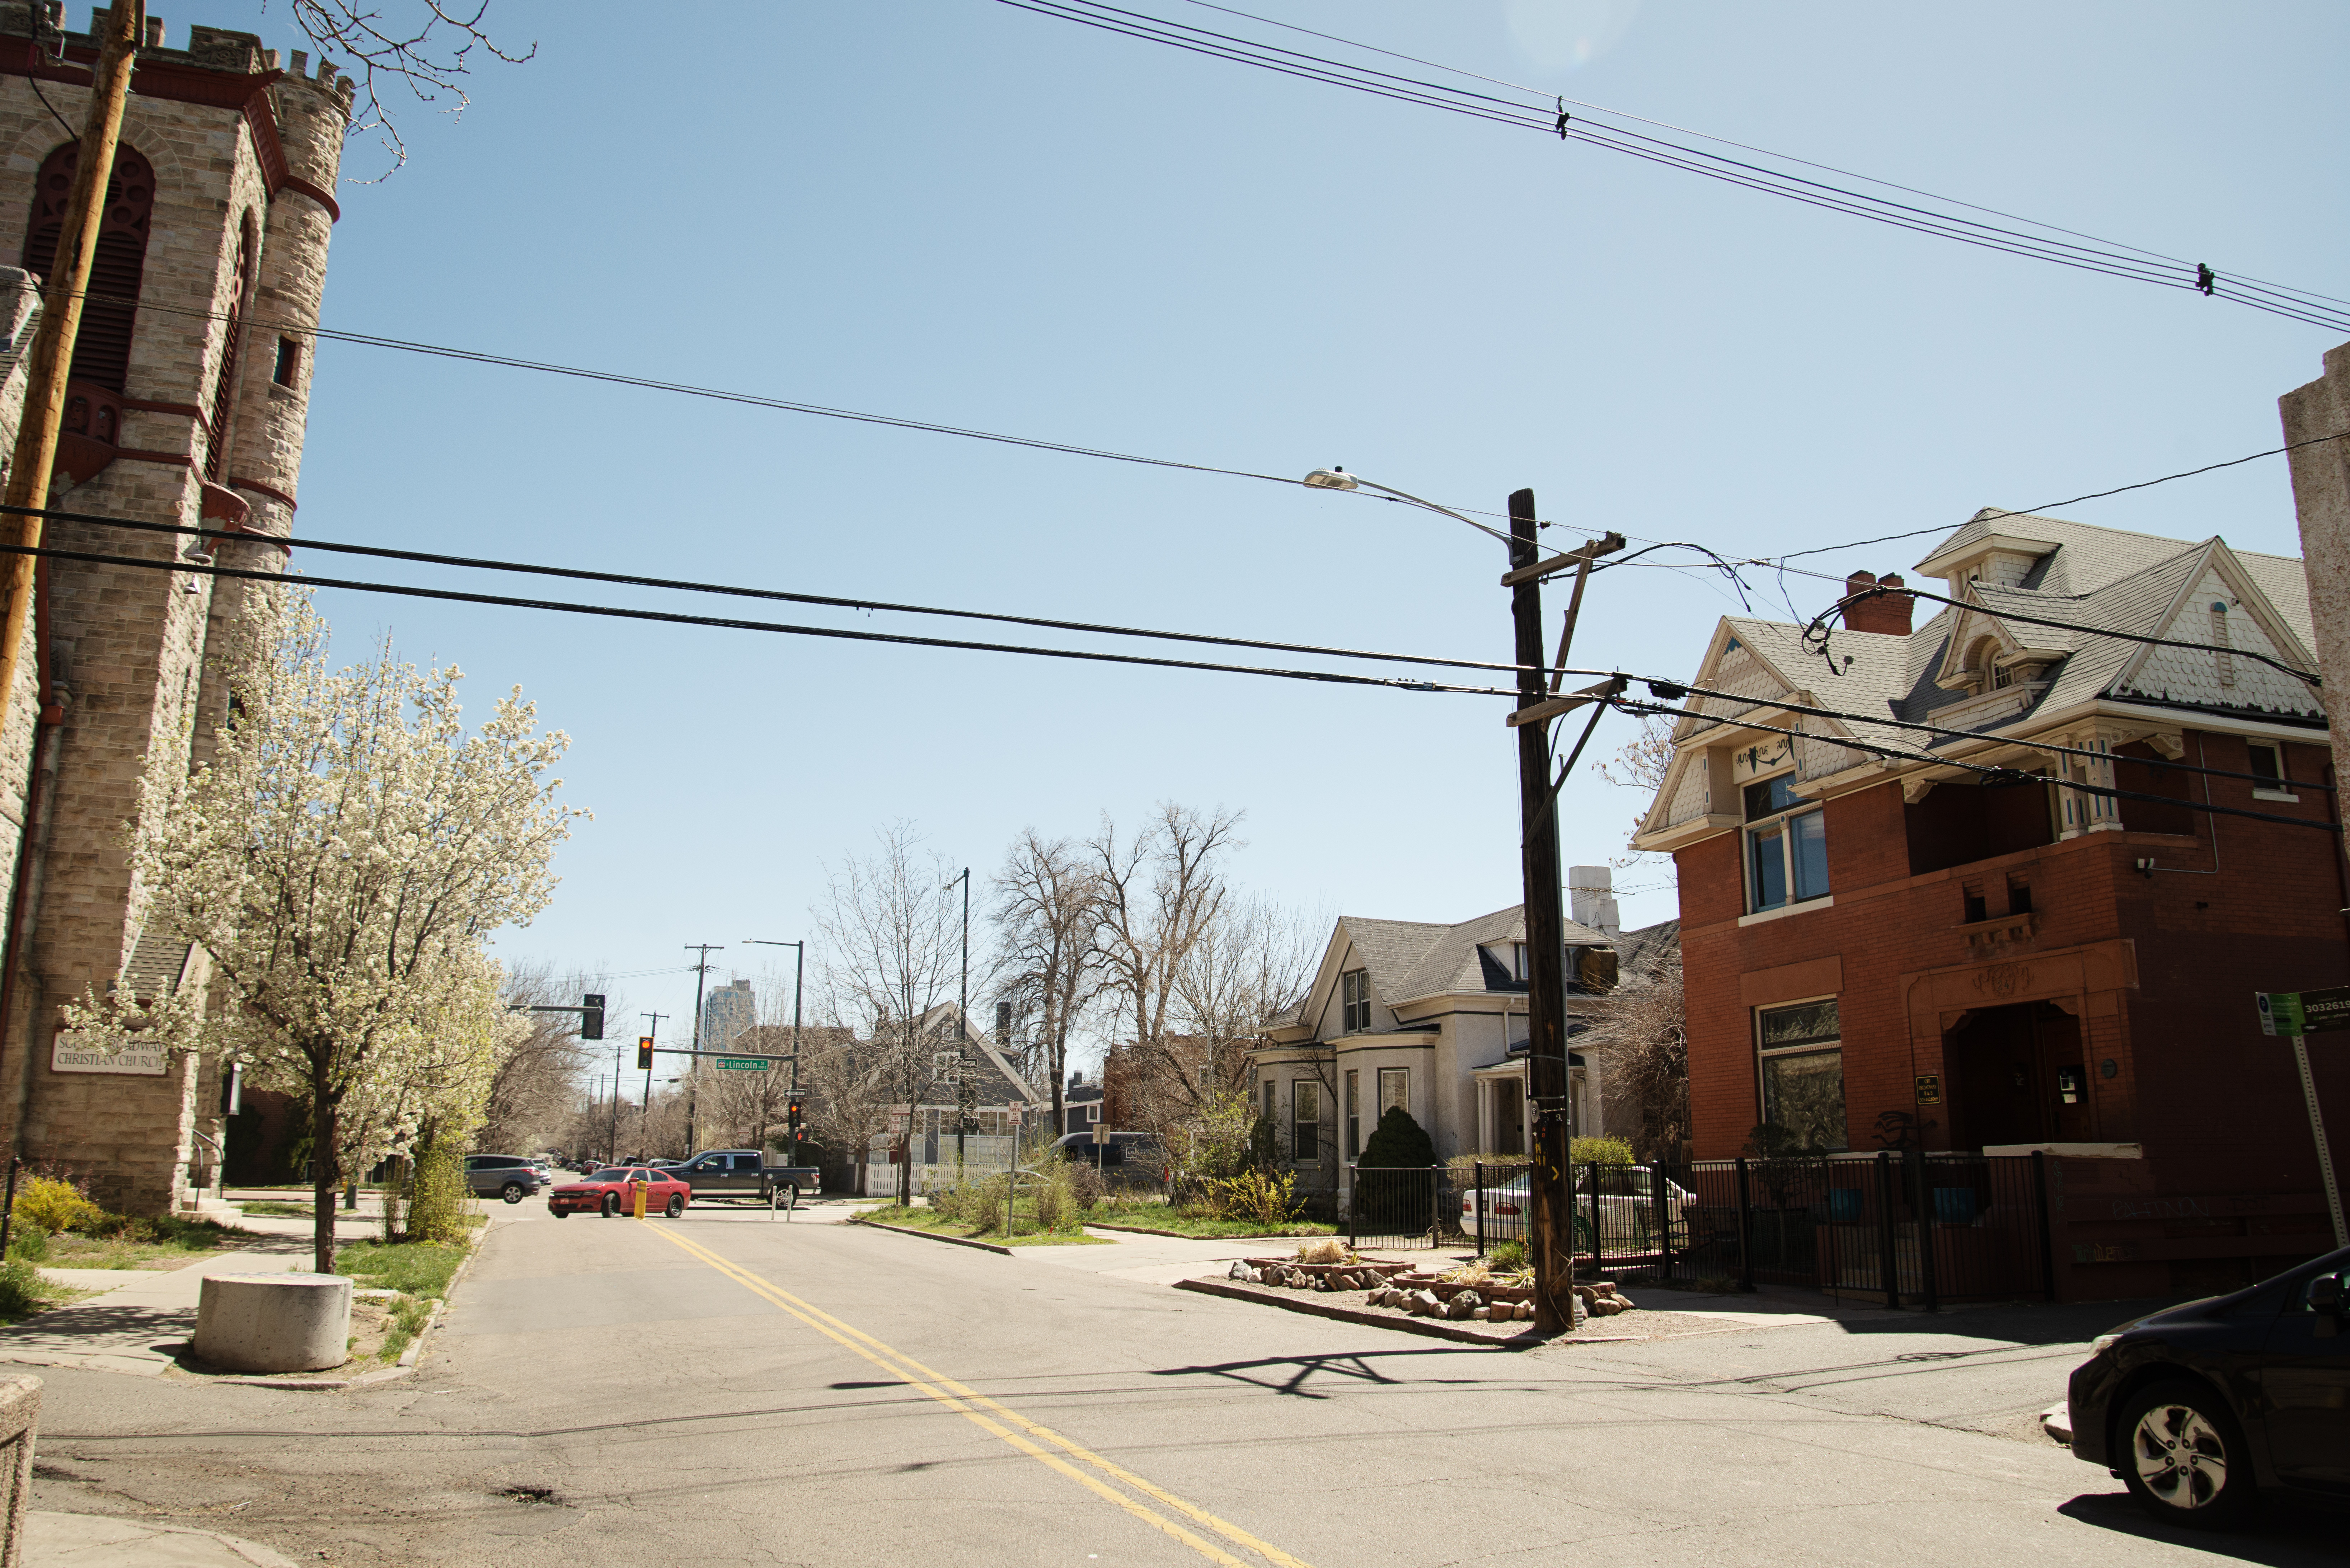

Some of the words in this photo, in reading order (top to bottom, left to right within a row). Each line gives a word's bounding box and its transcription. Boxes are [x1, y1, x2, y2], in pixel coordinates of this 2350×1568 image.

[1997, 979, 2009, 990] 24
[2305, 1000, 2350, 1013] 3032619
[103, 1038, 164, 1052] ROADWAY
[57, 1053, 115, 1065] CHRISTIAN
[118, 1055, 163, 1067] CHURCH
[729, 1060, 757, 1069] Lincoln
